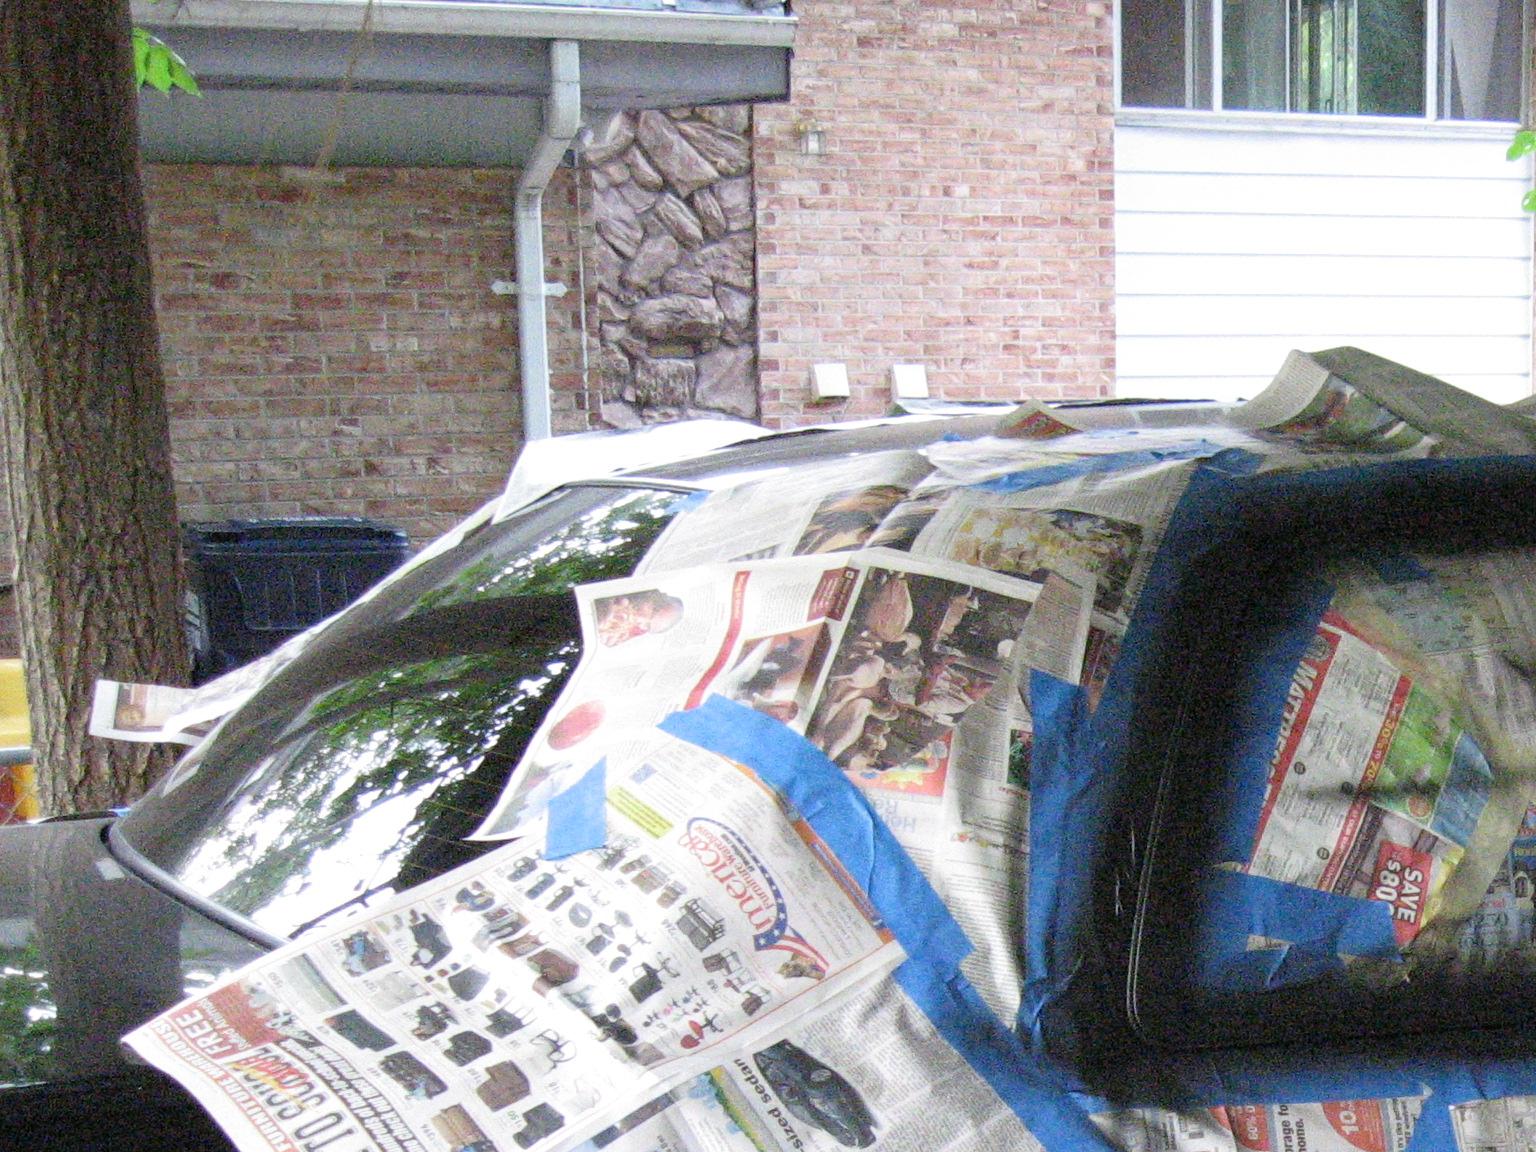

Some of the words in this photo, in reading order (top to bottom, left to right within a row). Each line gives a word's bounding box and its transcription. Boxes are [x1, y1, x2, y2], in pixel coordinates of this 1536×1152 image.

[1395, 865, 1424, 923] SAVE
[176, 1006, 232, 1057] FREE
[731, 1055, 773, 1107] sedan
[1278, 1103, 1289, 1115] fo
